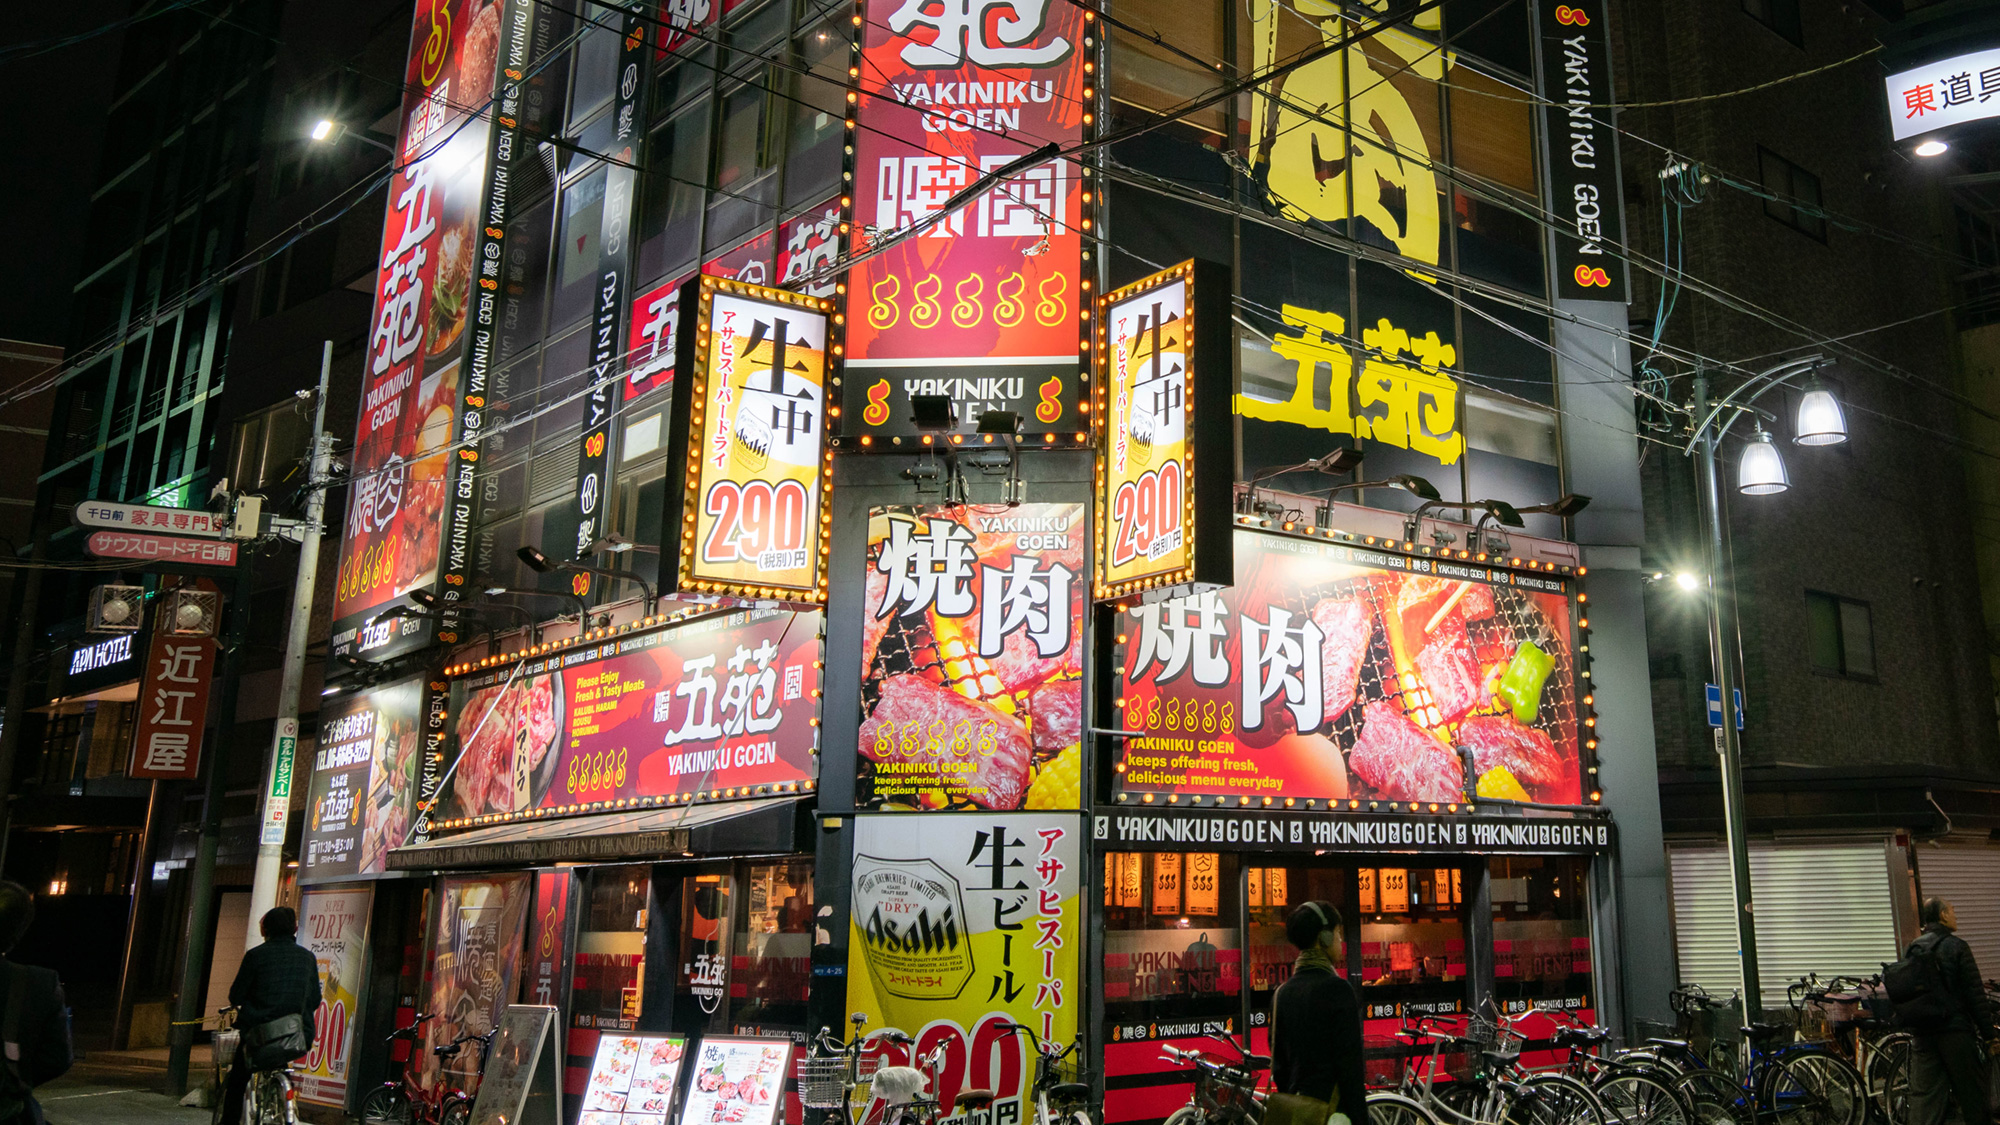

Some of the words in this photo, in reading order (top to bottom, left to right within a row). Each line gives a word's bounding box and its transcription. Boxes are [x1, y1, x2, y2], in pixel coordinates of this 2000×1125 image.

[509, 10, 528, 67] YAKINIKU
[893, 80, 1053, 105] YAKINIKU
[1563, 35, 1596, 170] YAKINIKU
[921, 108, 1020, 133] GOEN
[498, 130, 515, 161] GOEN
[1573, 182, 1603, 256] GOEN
[373, 160, 436, 377] 五苑
[478, 292, 495, 325] GOEN
[591, 271, 617, 426] YAKINIKU
[607, 180, 627, 256] GOEN
[471, 329, 490, 393] YAKINIKU
[1130, 301, 1182, 427] 生中
[366, 373, 414, 412] YAKINIKU
[712, 309, 738, 470] アサヒスーパードライ
[738, 317, 814, 446] 生中
[904, 377, 1024, 401] YAKINIKU
[1115, 316, 1128, 473] アサヒスーパードライ
[1232, 303, 1466, 466] 五苑
[371, 401, 402, 432] GOEN
[735, 427, 768, 458] Asahi
[457, 464, 475, 499] GOEN
[87, 508, 125, 522] 千日前
[131, 509, 222, 533] 家具専門
[706, 483, 806, 562] 290
[979, 517, 1068, 533] YAKINIKU
[1115, 461, 1181, 566] 290
[96, 535, 233, 562] サウスロード千日前
[450, 503, 470, 571] YAKINIKU
[1016, 534, 1068, 550] GOEN
[1262, 538, 1298, 552] YAKINIKU
[1354, 552, 1386, 566] YAKINIKU
[1388, 556, 1405, 568] GOEN
[1438, 564, 1468, 578] YAKINIKU
[1470, 568, 1486, 580] GOEN
[1515, 576, 1544, 590] YAKINIKU
[1545, 579, 1561, 591] GOEN
[876, 518, 1072, 658] 焼肉
[94, 634, 132, 668] HOTEL
[1130, 591, 1325, 736] 焼肉
[575, 689, 594, 703] Fresh
[595, 687, 601, 699] &
[602, 684, 622, 698] Tasty
[622, 679, 645, 693] Meats
[576, 676, 599, 690] Please
[600, 670, 619, 685] Enjoy
[664, 639, 783, 746] 五苑
[143, 643, 203, 771] 近江屋
[595, 700, 618, 713] HARAMI
[570, 739, 580, 748] etc
[668, 746, 731, 777] YAKINIKU
[734, 741, 776, 768] GOEN
[1129, 737, 1194, 753] YAKINIKU
[1198, 740, 1235, 754] GOEN
[875, 762, 937, 775] YAKINIKU
[941, 763, 977, 774] GOEN
[1127, 753, 1168, 769] keeps
[1170, 755, 1220, 773] offering
[1223, 759, 1259, 774] fresh,
[874, 776, 902, 787] keeps
[904, 776, 941, 787] offering
[943, 776, 969, 787] fresh,
[874, 785, 916, 796] delicious
[918, 787, 944, 795] menu
[946, 786, 988, 796] everyday
[1127, 770, 1187, 785] delicious
[1190, 775, 1225, 787] menu
[1228, 775, 1283, 791] everyday
[322, 787, 350, 822] 五苑
[1116, 816, 1208, 842] YAKINIKU
[1226, 820, 1284, 843] GOEN
[1309, 821, 1386, 844] YAKINIKU
[1402, 823, 1450, 845] GOEN
[1472, 824, 1538, 845] YAKINIKU
[1551, 825, 1594, 845] GOEN
[874, 873, 907, 885] BREWERIES
[910, 879, 937, 901] LIMITED
[325, 900, 345, 912] SUPER
[965, 826, 1030, 1004] 生ビール
[866, 904, 958, 954] Asahi
[1131, 950, 1215, 974] YAKINIKU
[888, 972, 942, 988] スーパードライ
[1438, 1001, 1455, 1012] GOEN
[1565, 997, 1582, 1008] GOEN
[1158, 1023, 1200, 1036] YAKINIKU
